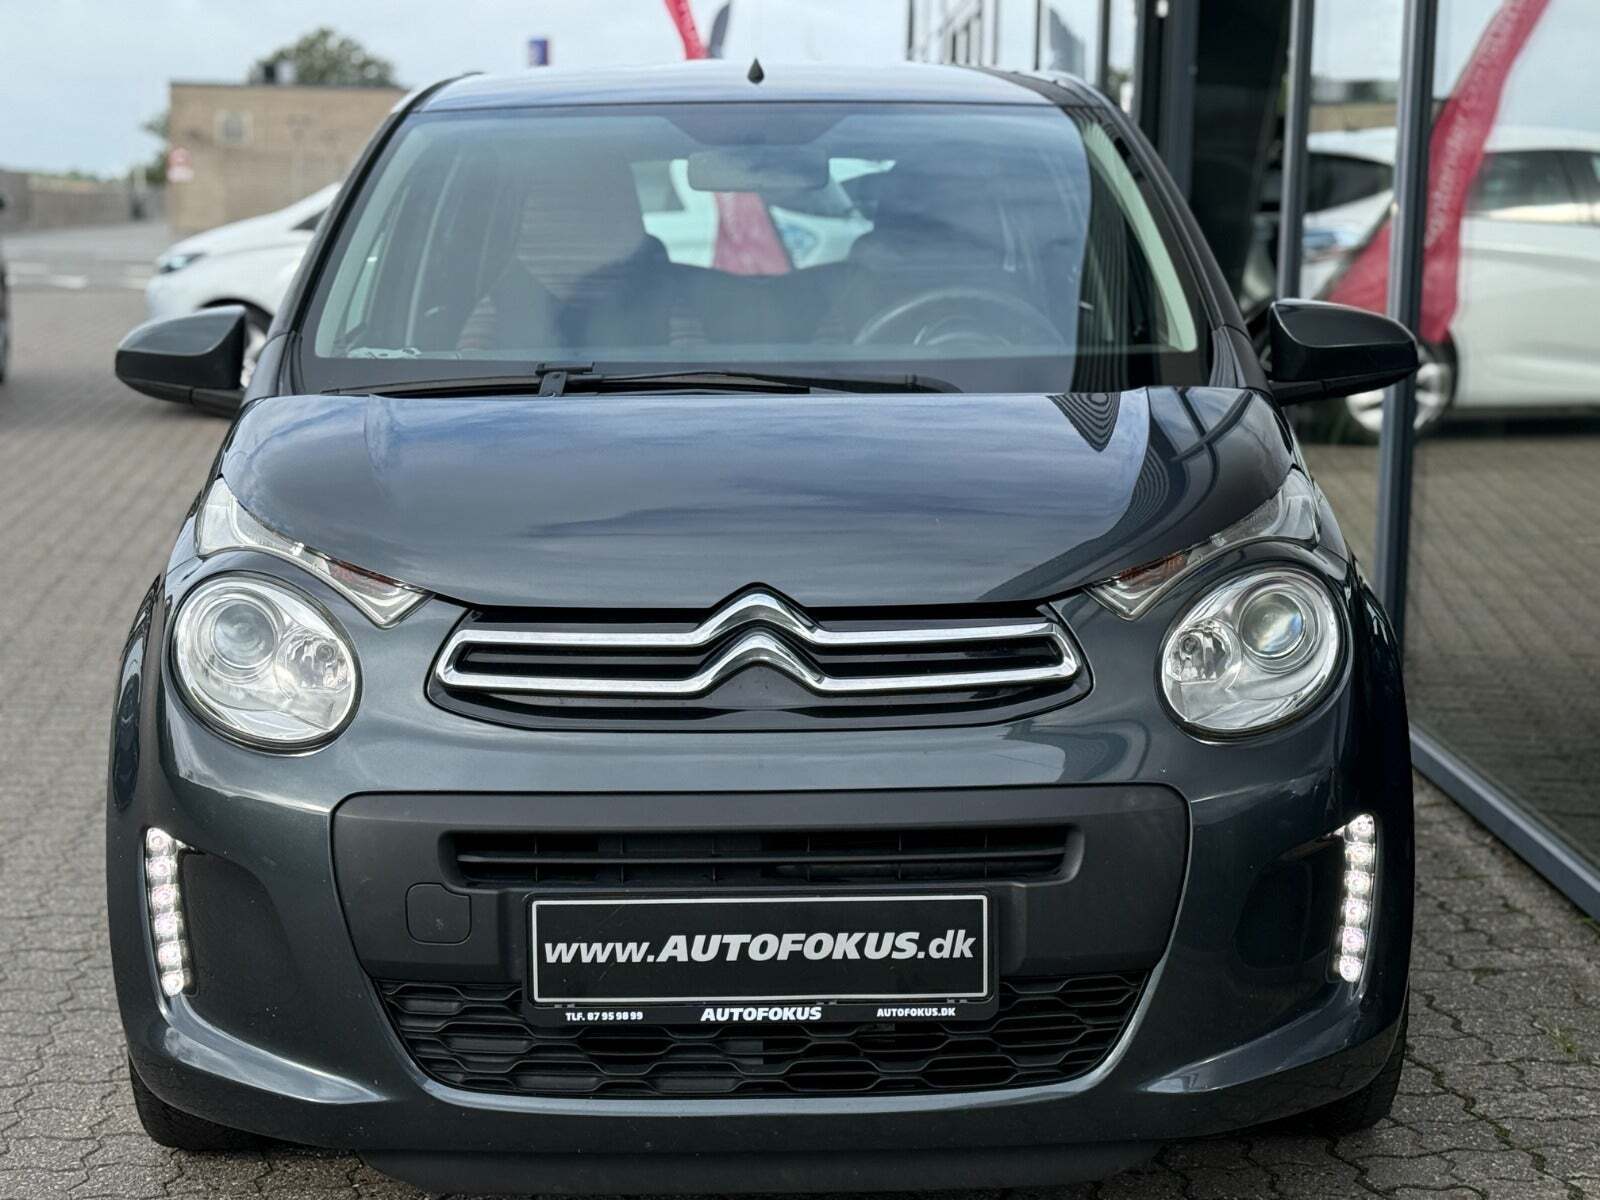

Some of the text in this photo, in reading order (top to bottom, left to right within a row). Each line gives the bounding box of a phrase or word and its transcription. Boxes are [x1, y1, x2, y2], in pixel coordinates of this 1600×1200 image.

[544, 929, 977, 964] www.AUTOFOKUS.dk
[565, 1012, 586, 1022] TLF.
[601, 1012, 615, 1021] 95
[700, 1007, 822, 1022] AUTOFOKUS
[876, 1007, 956, 1018] AUTOFOKUS.DK
